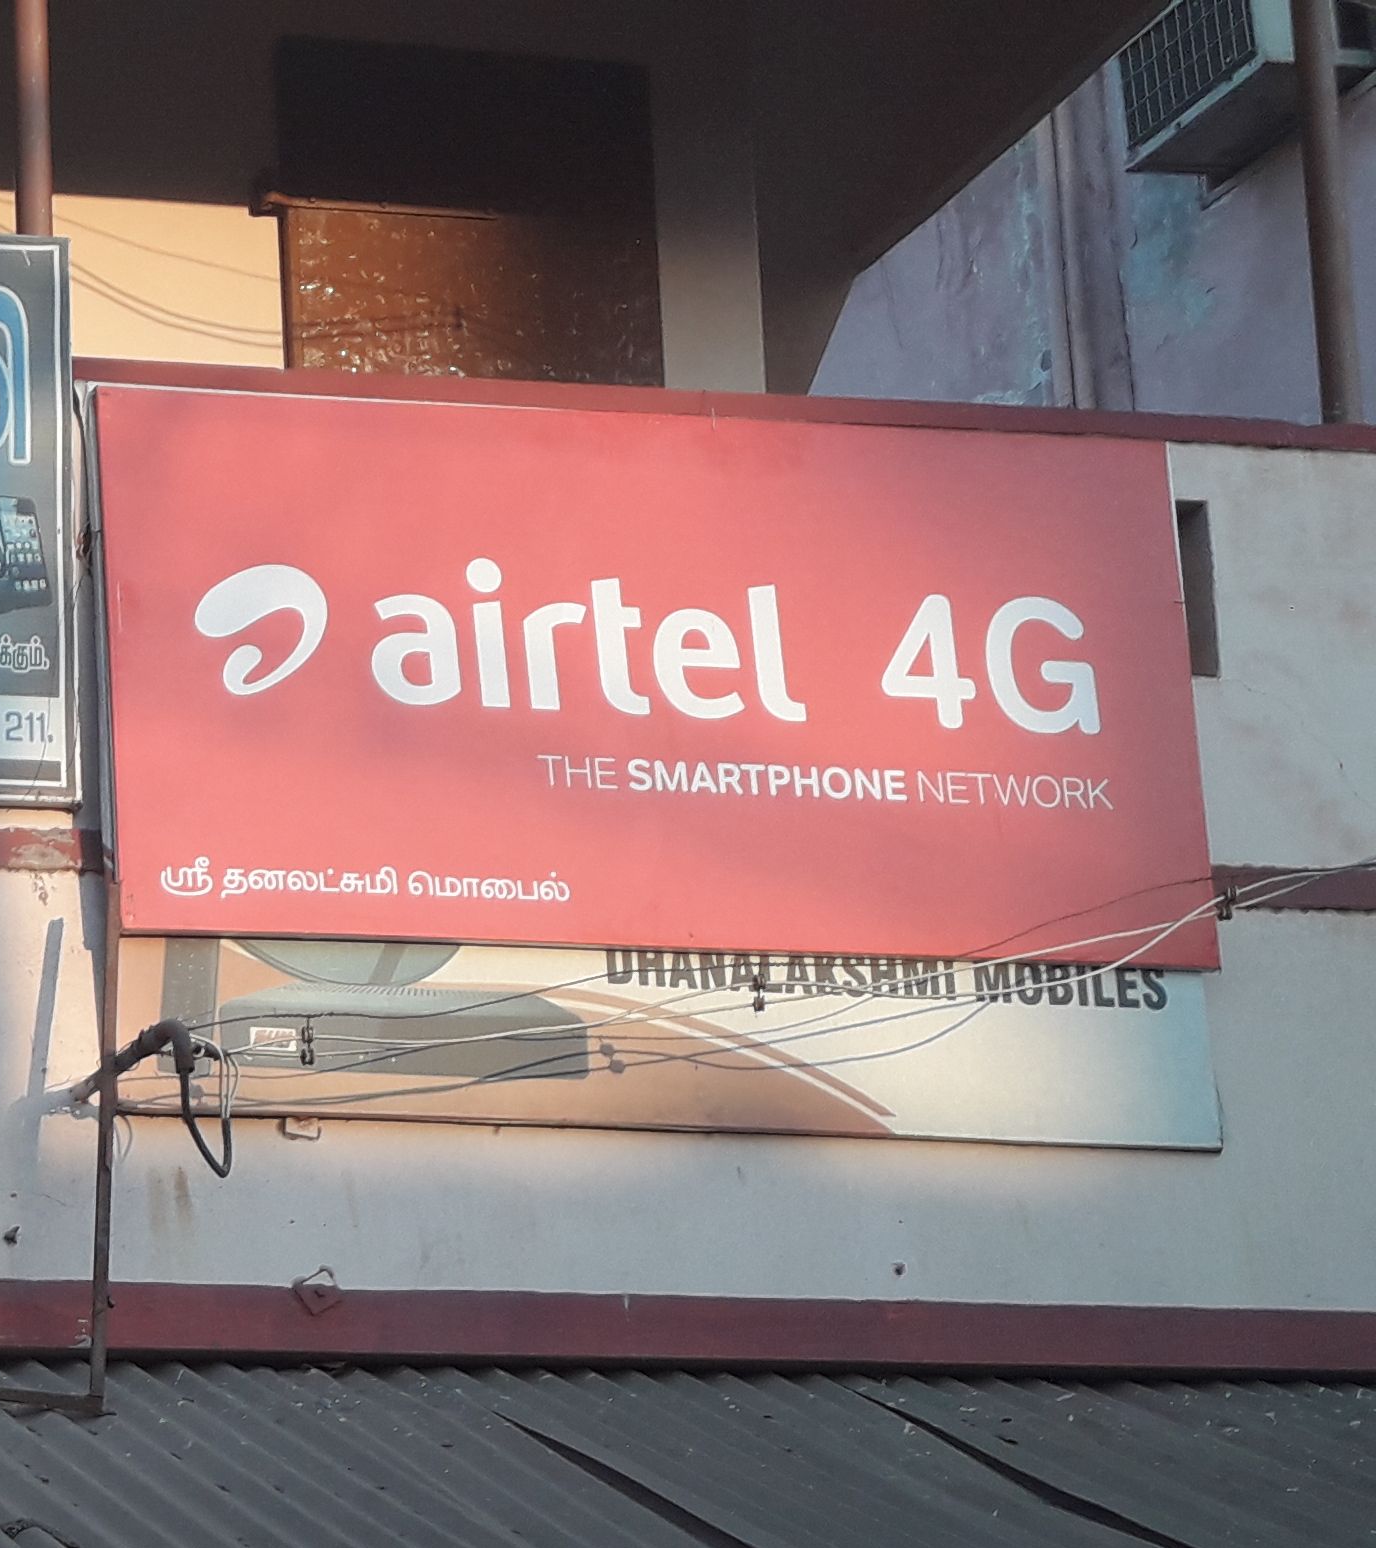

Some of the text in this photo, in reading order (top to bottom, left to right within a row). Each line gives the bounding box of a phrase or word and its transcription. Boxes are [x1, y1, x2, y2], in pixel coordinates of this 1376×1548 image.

[371, 557, 1101, 735] airtel 4G
[537, 753, 1114, 811] THE SMARTPHONE NETWORK
[220, 866, 399, 899] தனலட்சுமி
[407, 871, 571, 902] மொபைல்
[606, 949, 1168, 1012] DHANALAKSHMI MOBILES
